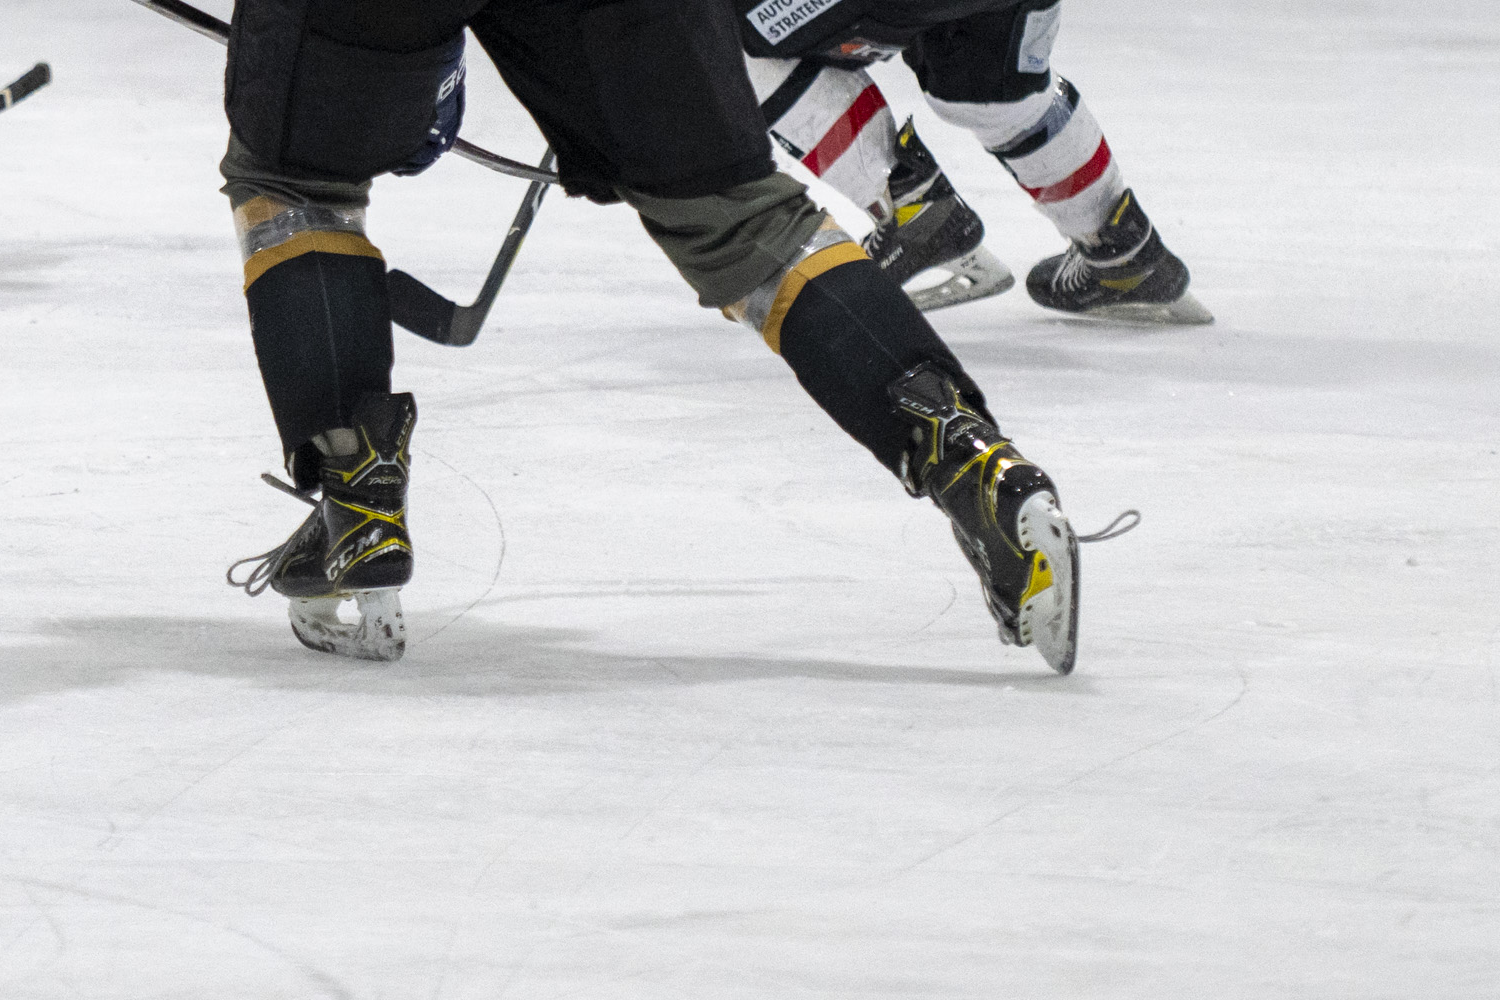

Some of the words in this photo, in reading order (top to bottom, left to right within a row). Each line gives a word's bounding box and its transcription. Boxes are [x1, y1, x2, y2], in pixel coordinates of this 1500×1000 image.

[899, 396, 935, 415] CCM
[368, 475, 403, 487] TACKS
[325, 527, 384, 582] CCM
